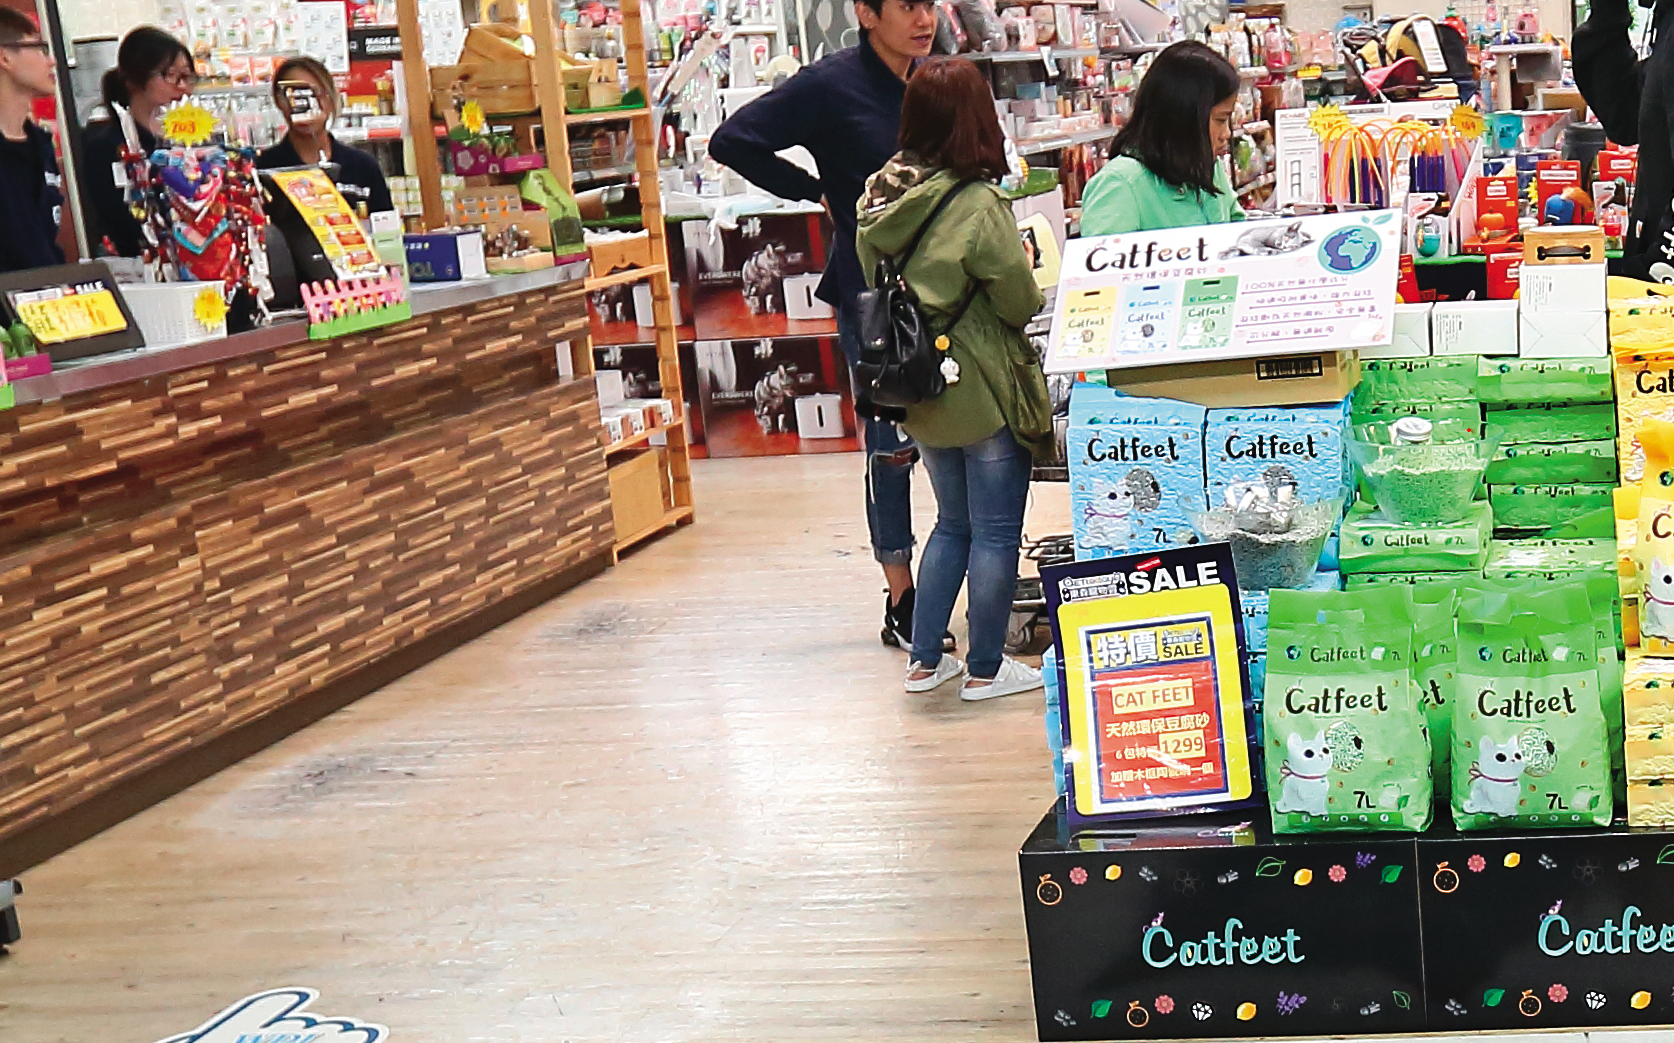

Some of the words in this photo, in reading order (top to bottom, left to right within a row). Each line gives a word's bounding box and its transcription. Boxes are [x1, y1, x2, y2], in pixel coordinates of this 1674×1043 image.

[1085, 238, 1209, 272] Catfeet
[1087, 435, 1181, 463] Catfeet
[1225, 434, 1318, 460] Catfeet
[1153, 527, 1172, 545] 7L
[1384, 533, 1429, 549] Catfeet
[1129, 561, 1220, 595] SALE
[1096, 630, 1160, 665] 特價
[1163, 643, 1203, 659] SALE
[1309, 646, 1366, 663] Catfeet
[1114, 691, 1146, 710] CAT
[1152, 686, 1192, 705] FEET
[1285, 684, 1388, 714] Catfeet
[1478, 687, 1577, 719] Catfeet
[1106, 712, 1210, 738] 天然環保豆腐砂
[1161, 736, 1203, 755] 1299
[1353, 791, 1376, 809] 7L
[1546, 793, 1568, 810] 7L
[1142, 917, 1306, 968] Catfeet
